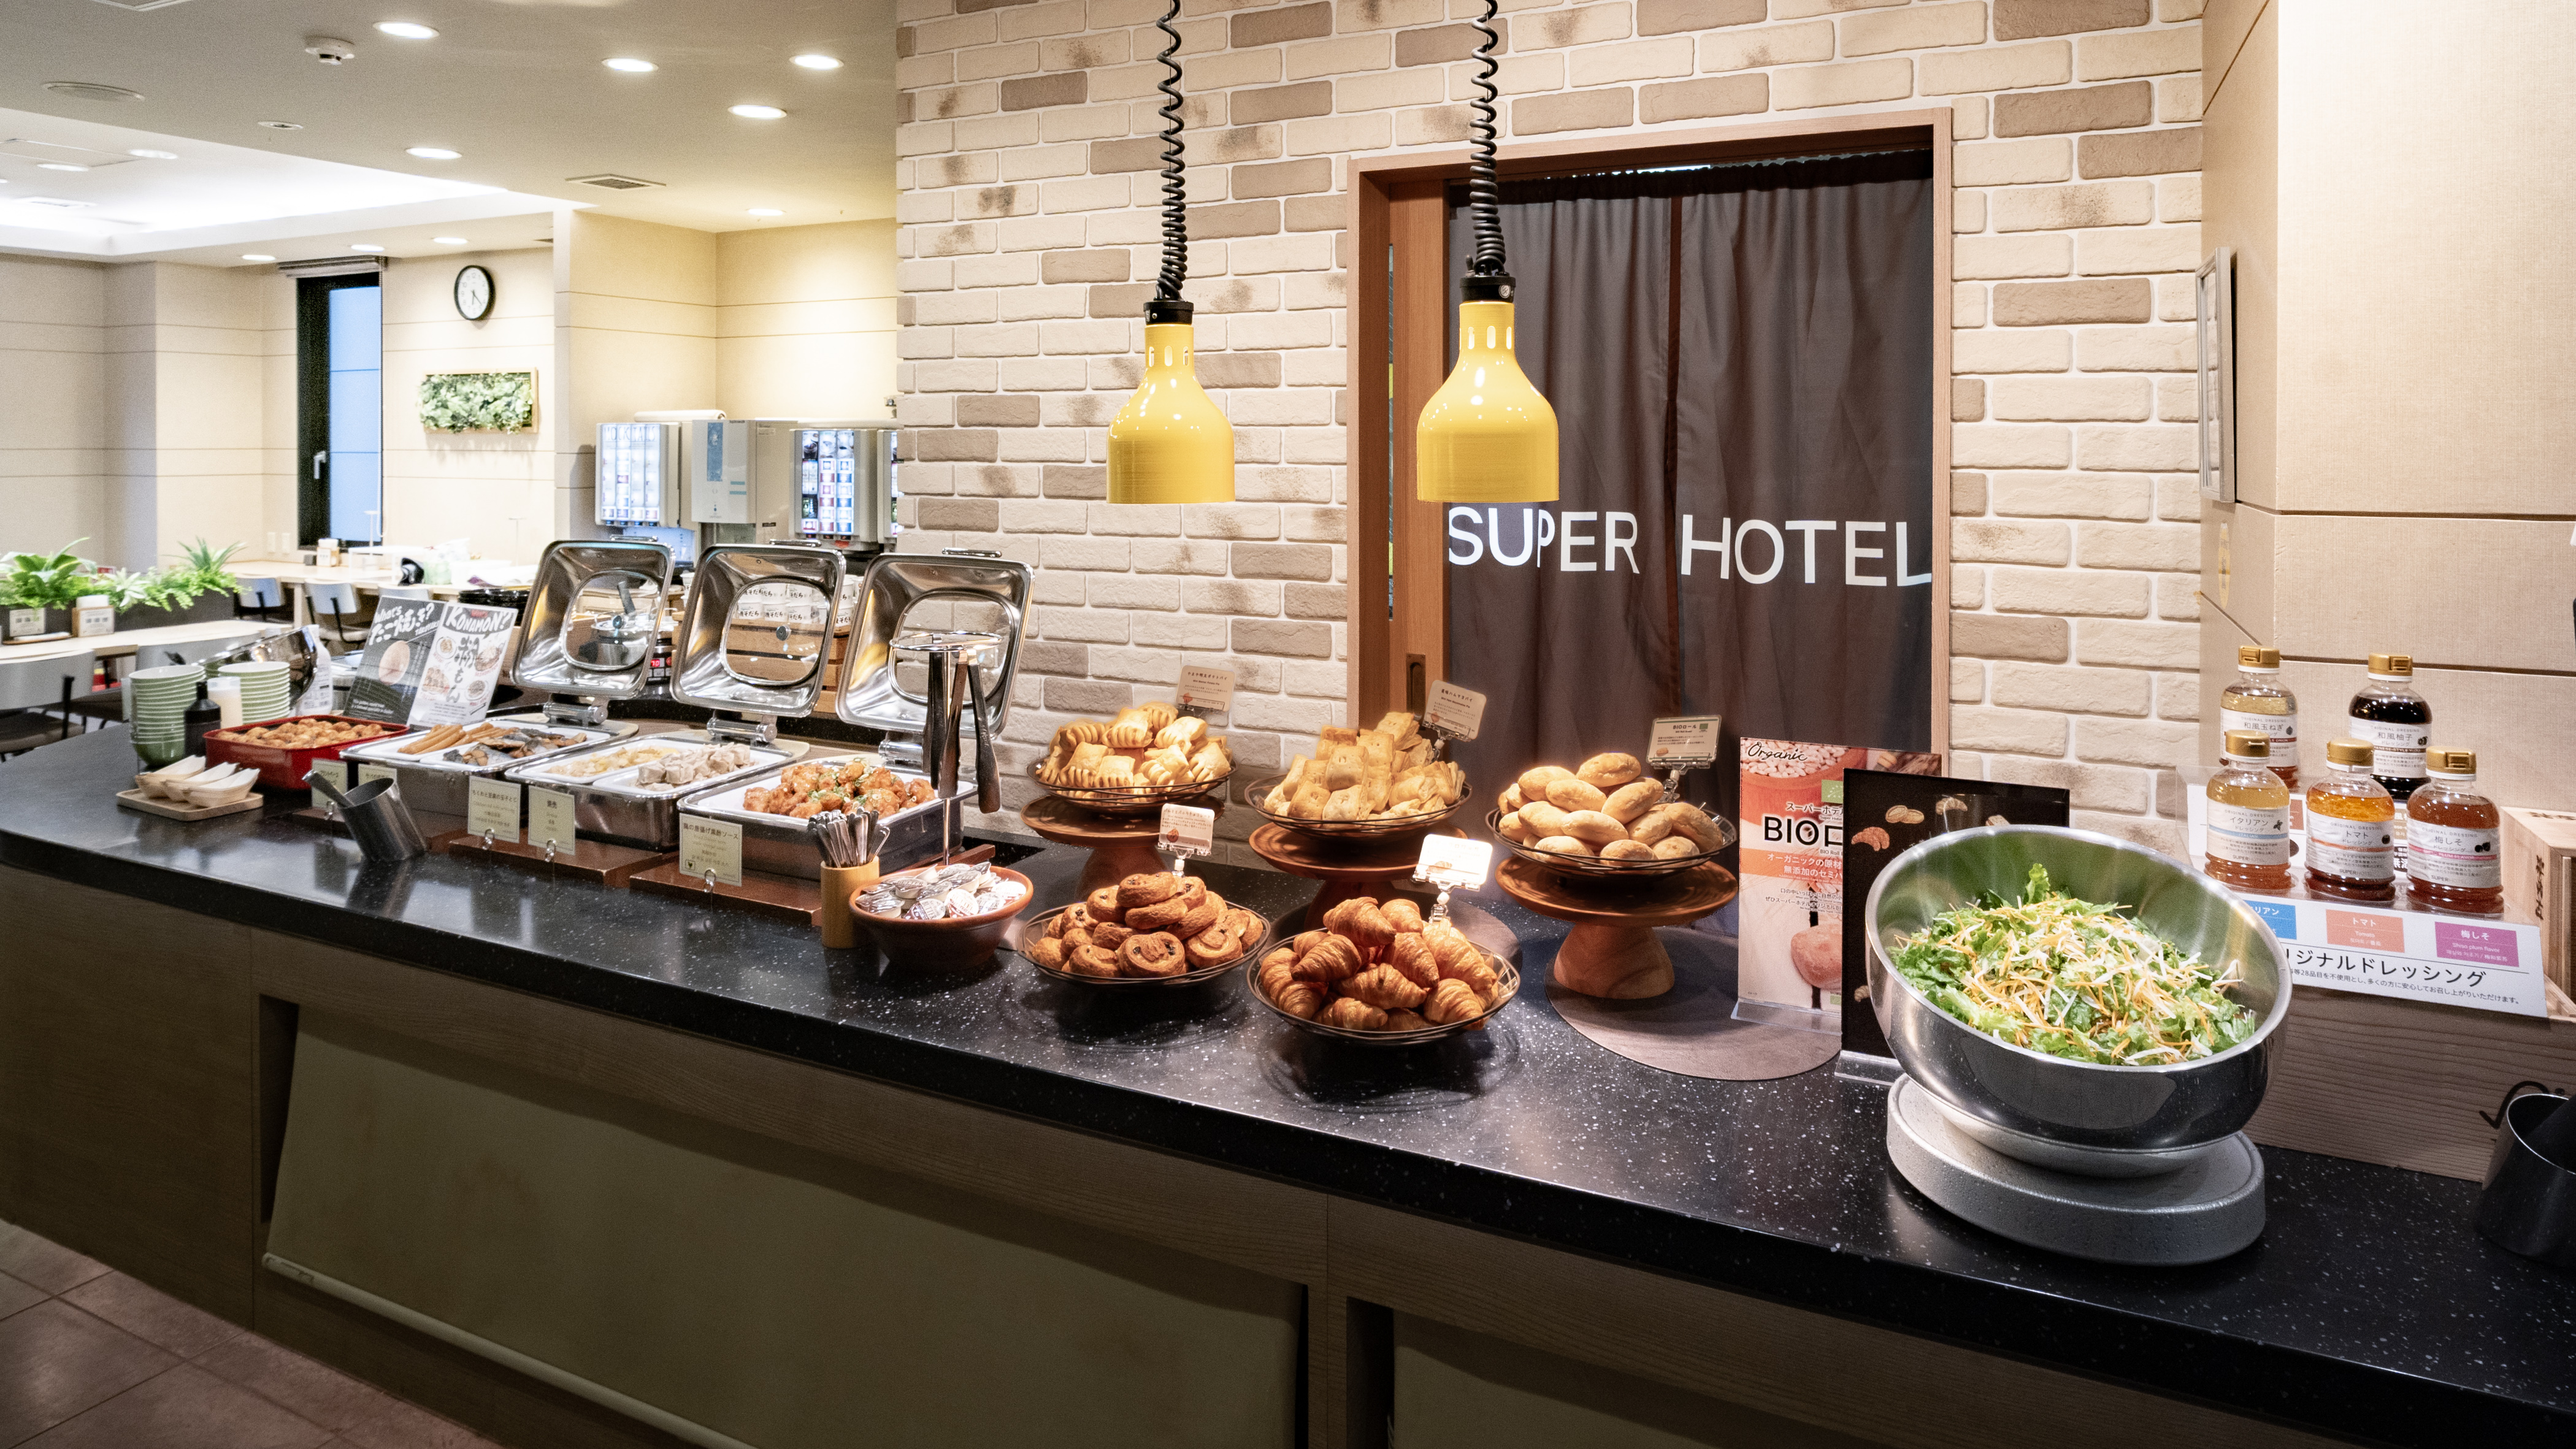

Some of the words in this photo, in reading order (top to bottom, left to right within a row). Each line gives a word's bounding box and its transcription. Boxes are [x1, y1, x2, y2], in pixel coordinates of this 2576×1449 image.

[1449, 507, 1640, 575] SUPER
[1681, 514, 1932, 587] HOTEL
[2244, 722, 2284, 732] 和風玉ねぎ
[2377, 732, 2413, 741] 和風柚子
[1747, 741, 1808, 762] Organic
[2229, 816, 2269, 827] イタリアン
[2346, 830, 2369, 839] トマト
[2421, 827, 2447, 836] ORIGINAL
[2434, 835, 2463, 846] 梅しそ
[1766, 853, 1842, 869] オーガニックの原材
[1781, 888, 1842, 900] 口の中いっぱいに自然の小
[2352, 917, 2377, 927] トマト
[2461, 930, 2490, 941] 梅しそ
